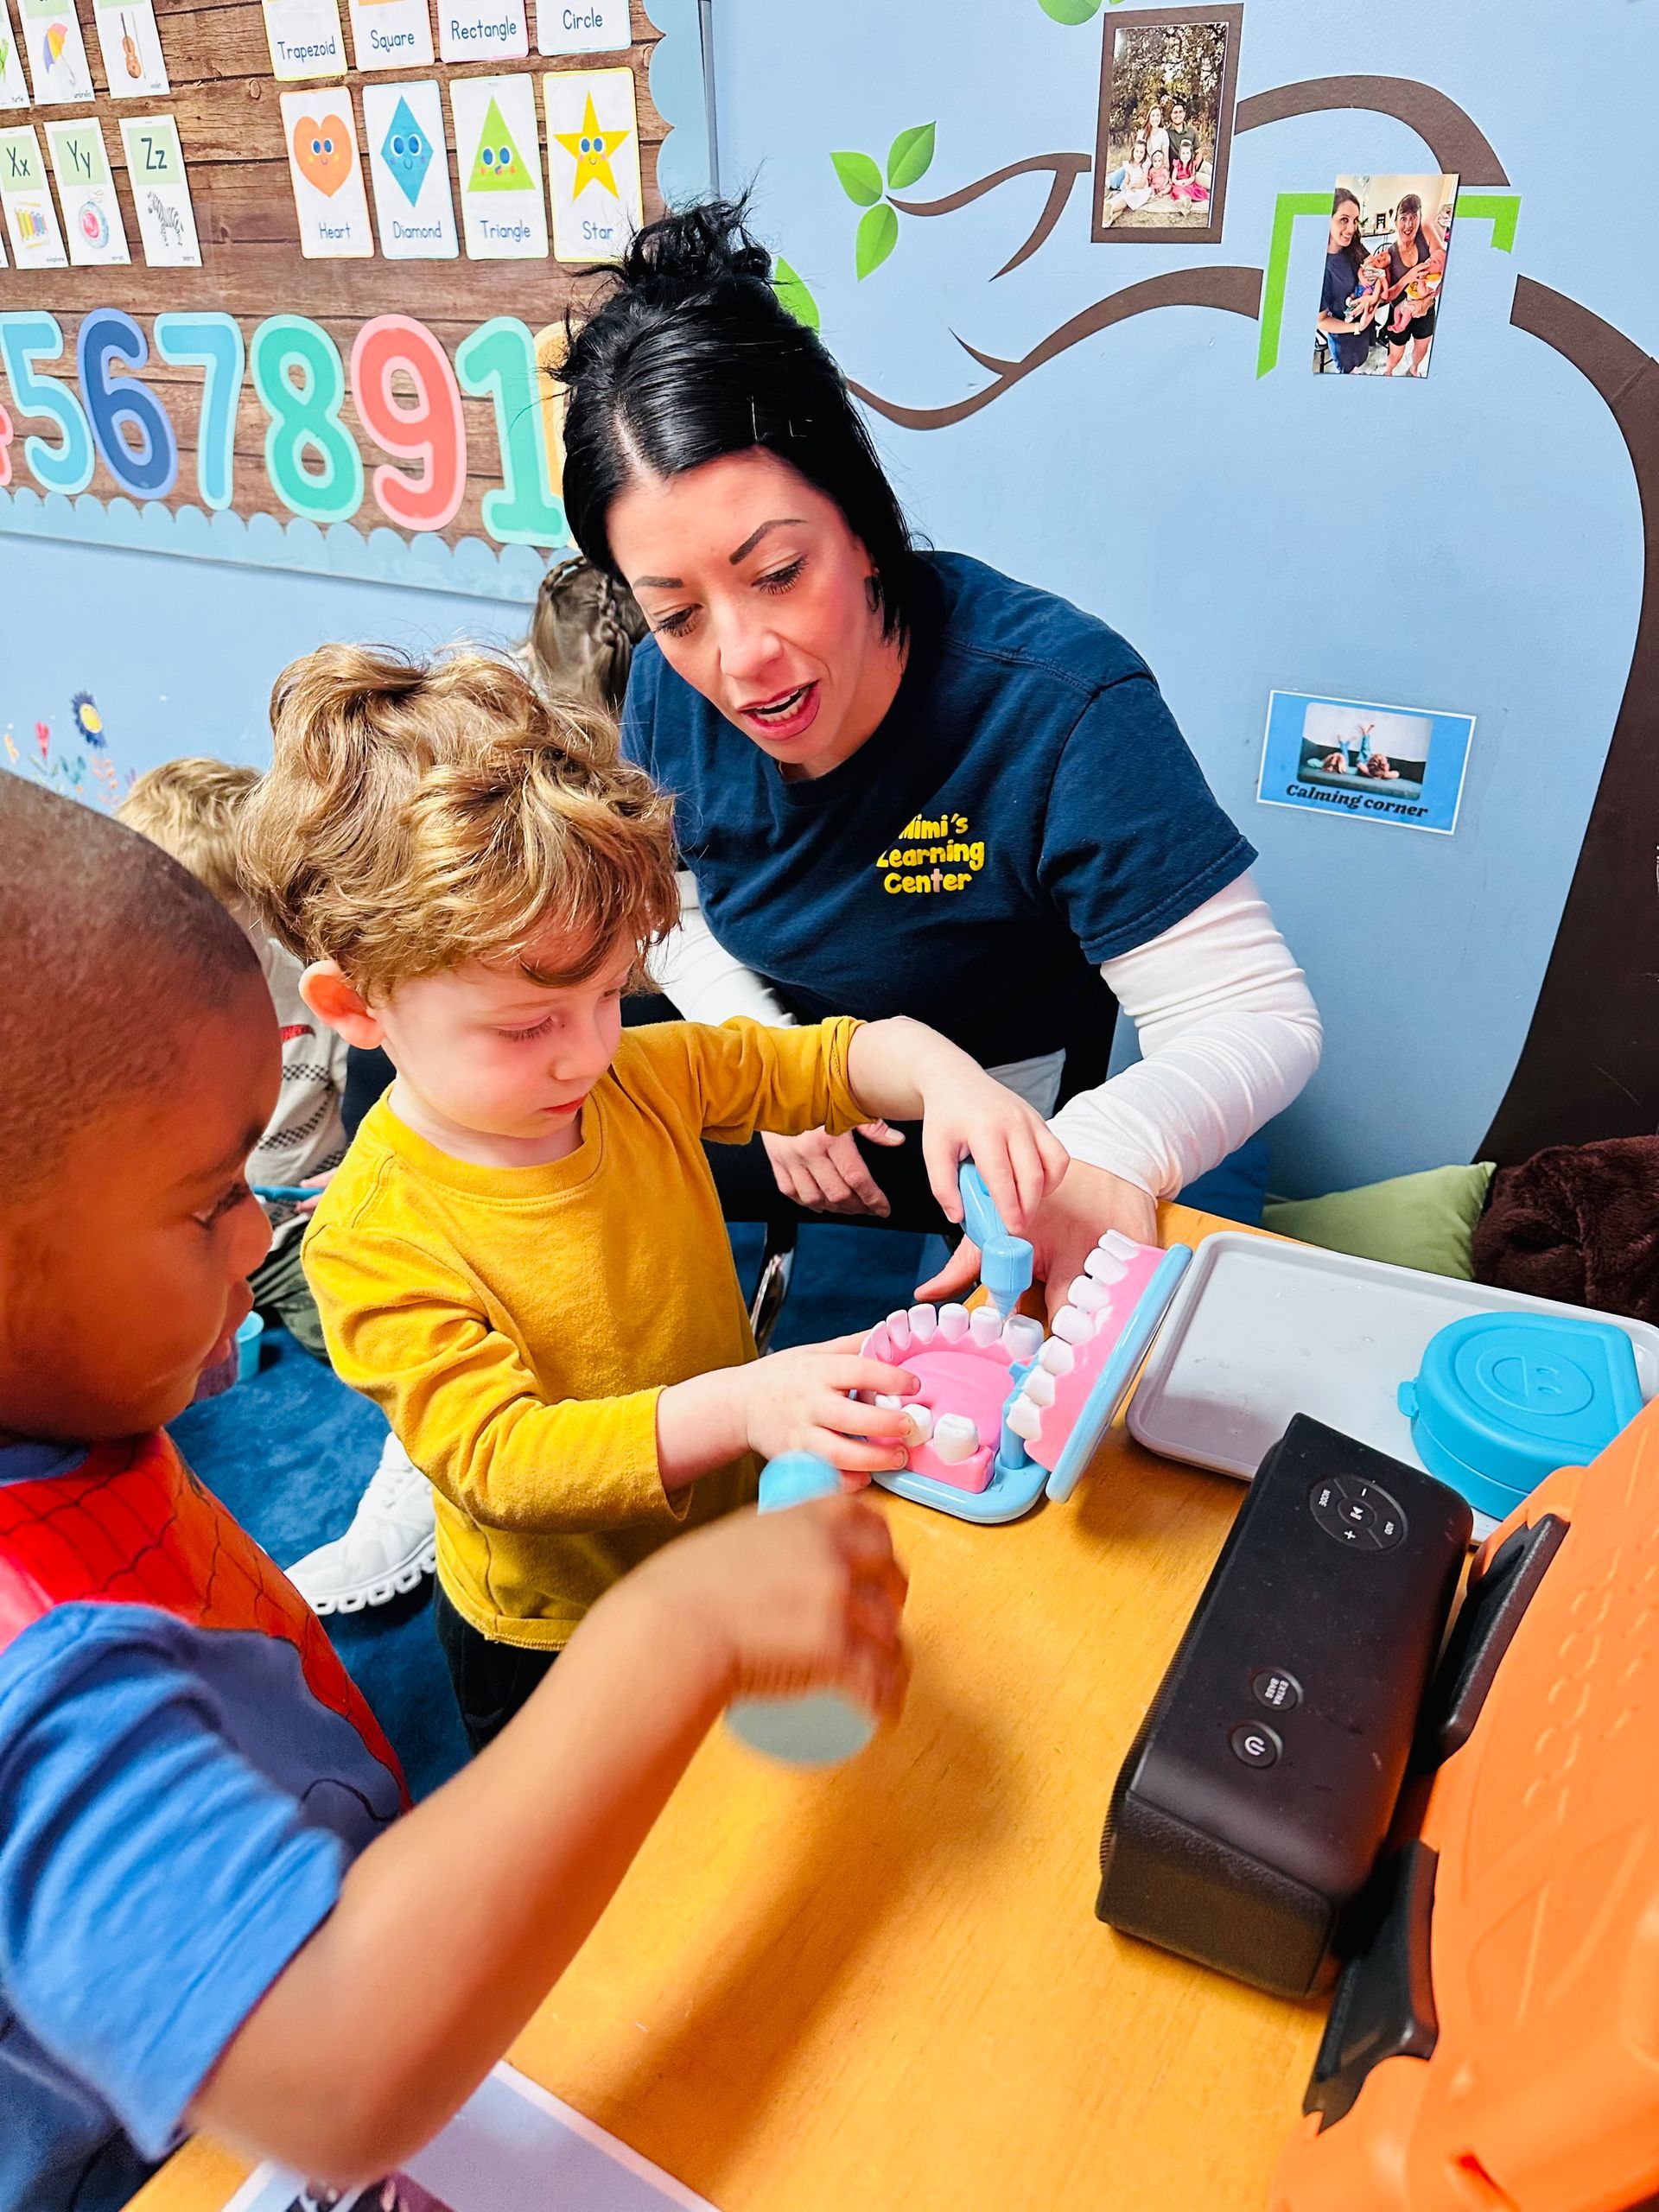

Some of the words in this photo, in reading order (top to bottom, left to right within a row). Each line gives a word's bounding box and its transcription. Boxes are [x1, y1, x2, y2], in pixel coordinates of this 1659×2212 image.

[451, 16, 517, 41] Rectangle
[563, 8, 603, 30] Circle
[277, 36, 336, 63] Trapezoid
[371, 29, 415, 53] Square
[6, 146, 30, 178] Xx
[67, 140, 91, 179] Yy
[140, 137, 168, 170] Zz
[319, 221, 351, 239] Heart
[393, 220, 442, 239] Diamond
[480, 220, 531, 243] Triangle
[582, 220, 613, 240] Star
[0, 311, 94, 494] 5
[78, 308, 178, 500] 6
[155, 312, 245, 511] 7
[251, 315, 364, 522] 8
[351, 314, 467, 531] 9
[1286, 783, 1363, 810] Calming
[1364, 798, 1428, 817] corner
[883, 868, 973, 894] Center
[1318, 1489, 1331, 1507] MODE
